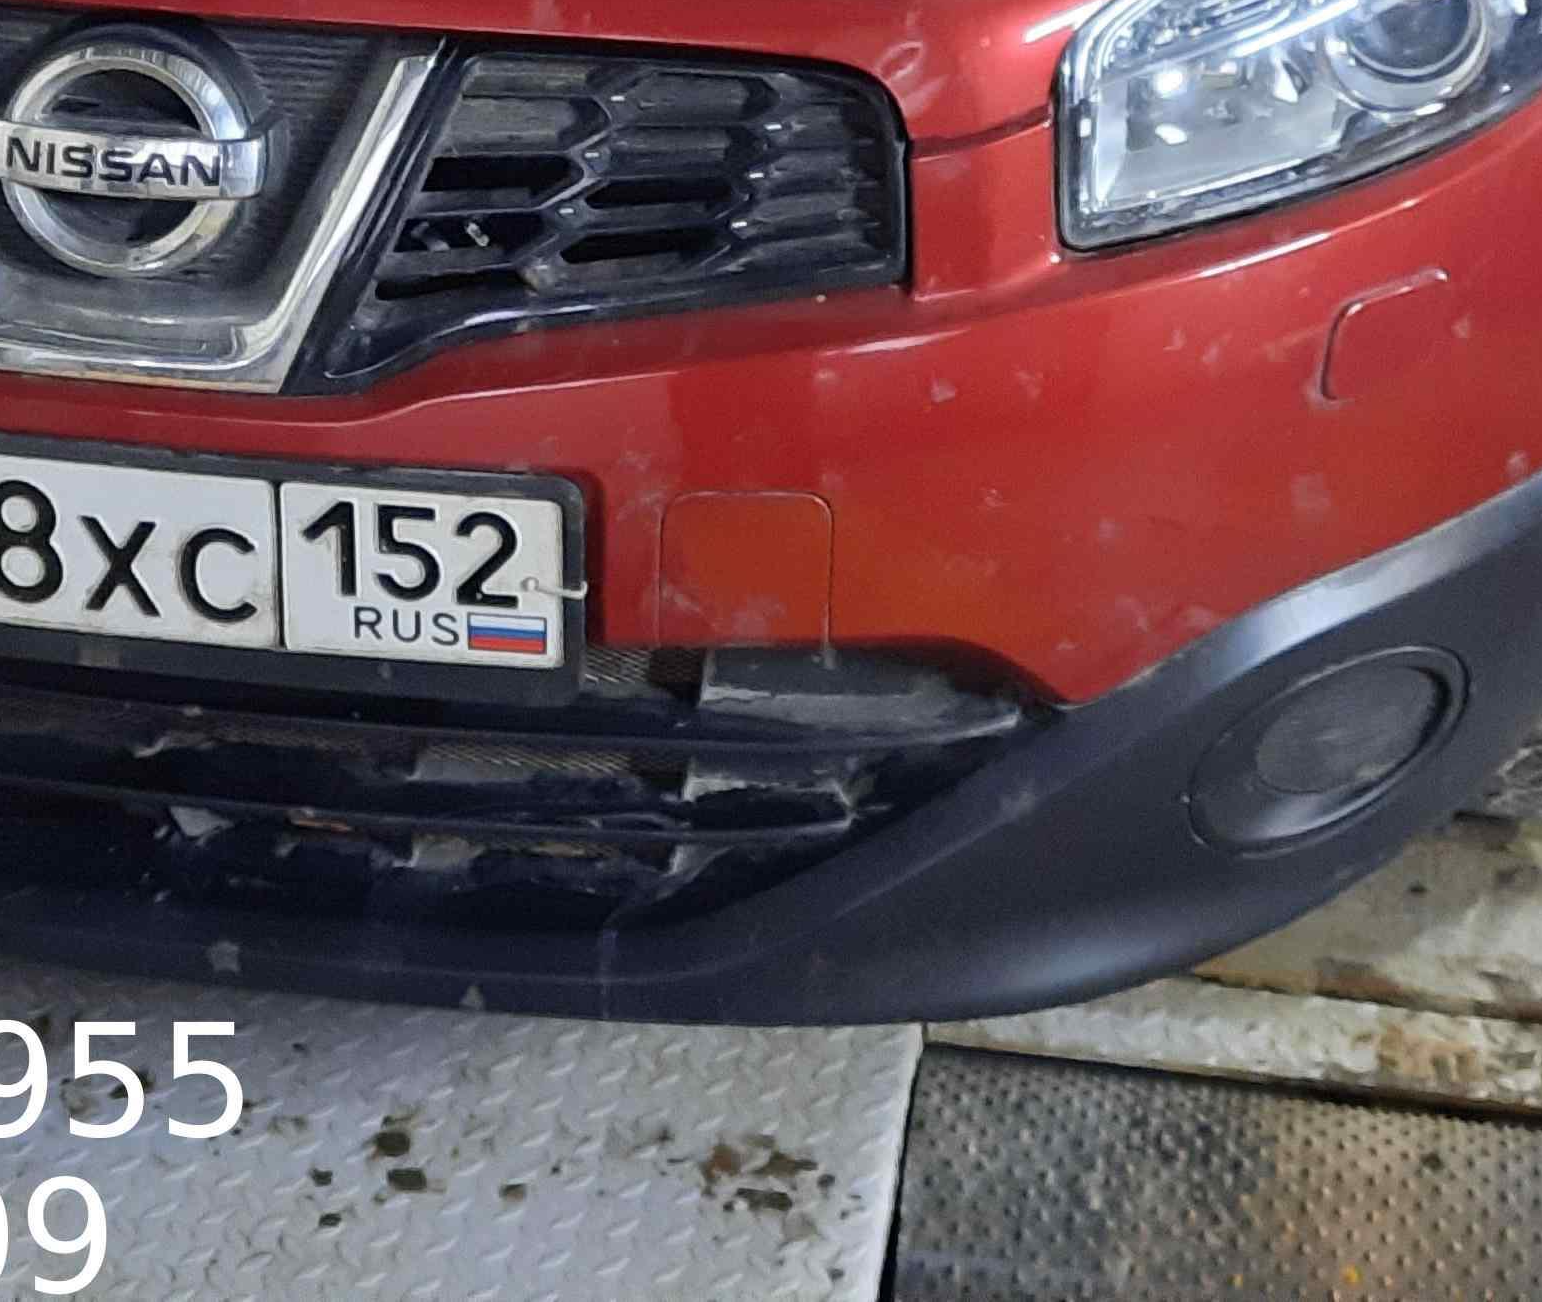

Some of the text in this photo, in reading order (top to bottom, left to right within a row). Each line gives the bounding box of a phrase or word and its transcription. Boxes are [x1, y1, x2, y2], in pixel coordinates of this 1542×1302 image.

[5, 136, 222, 188] NISSAN
[302, 501, 519, 609] 152
[353, 605, 461, 647] RUS
